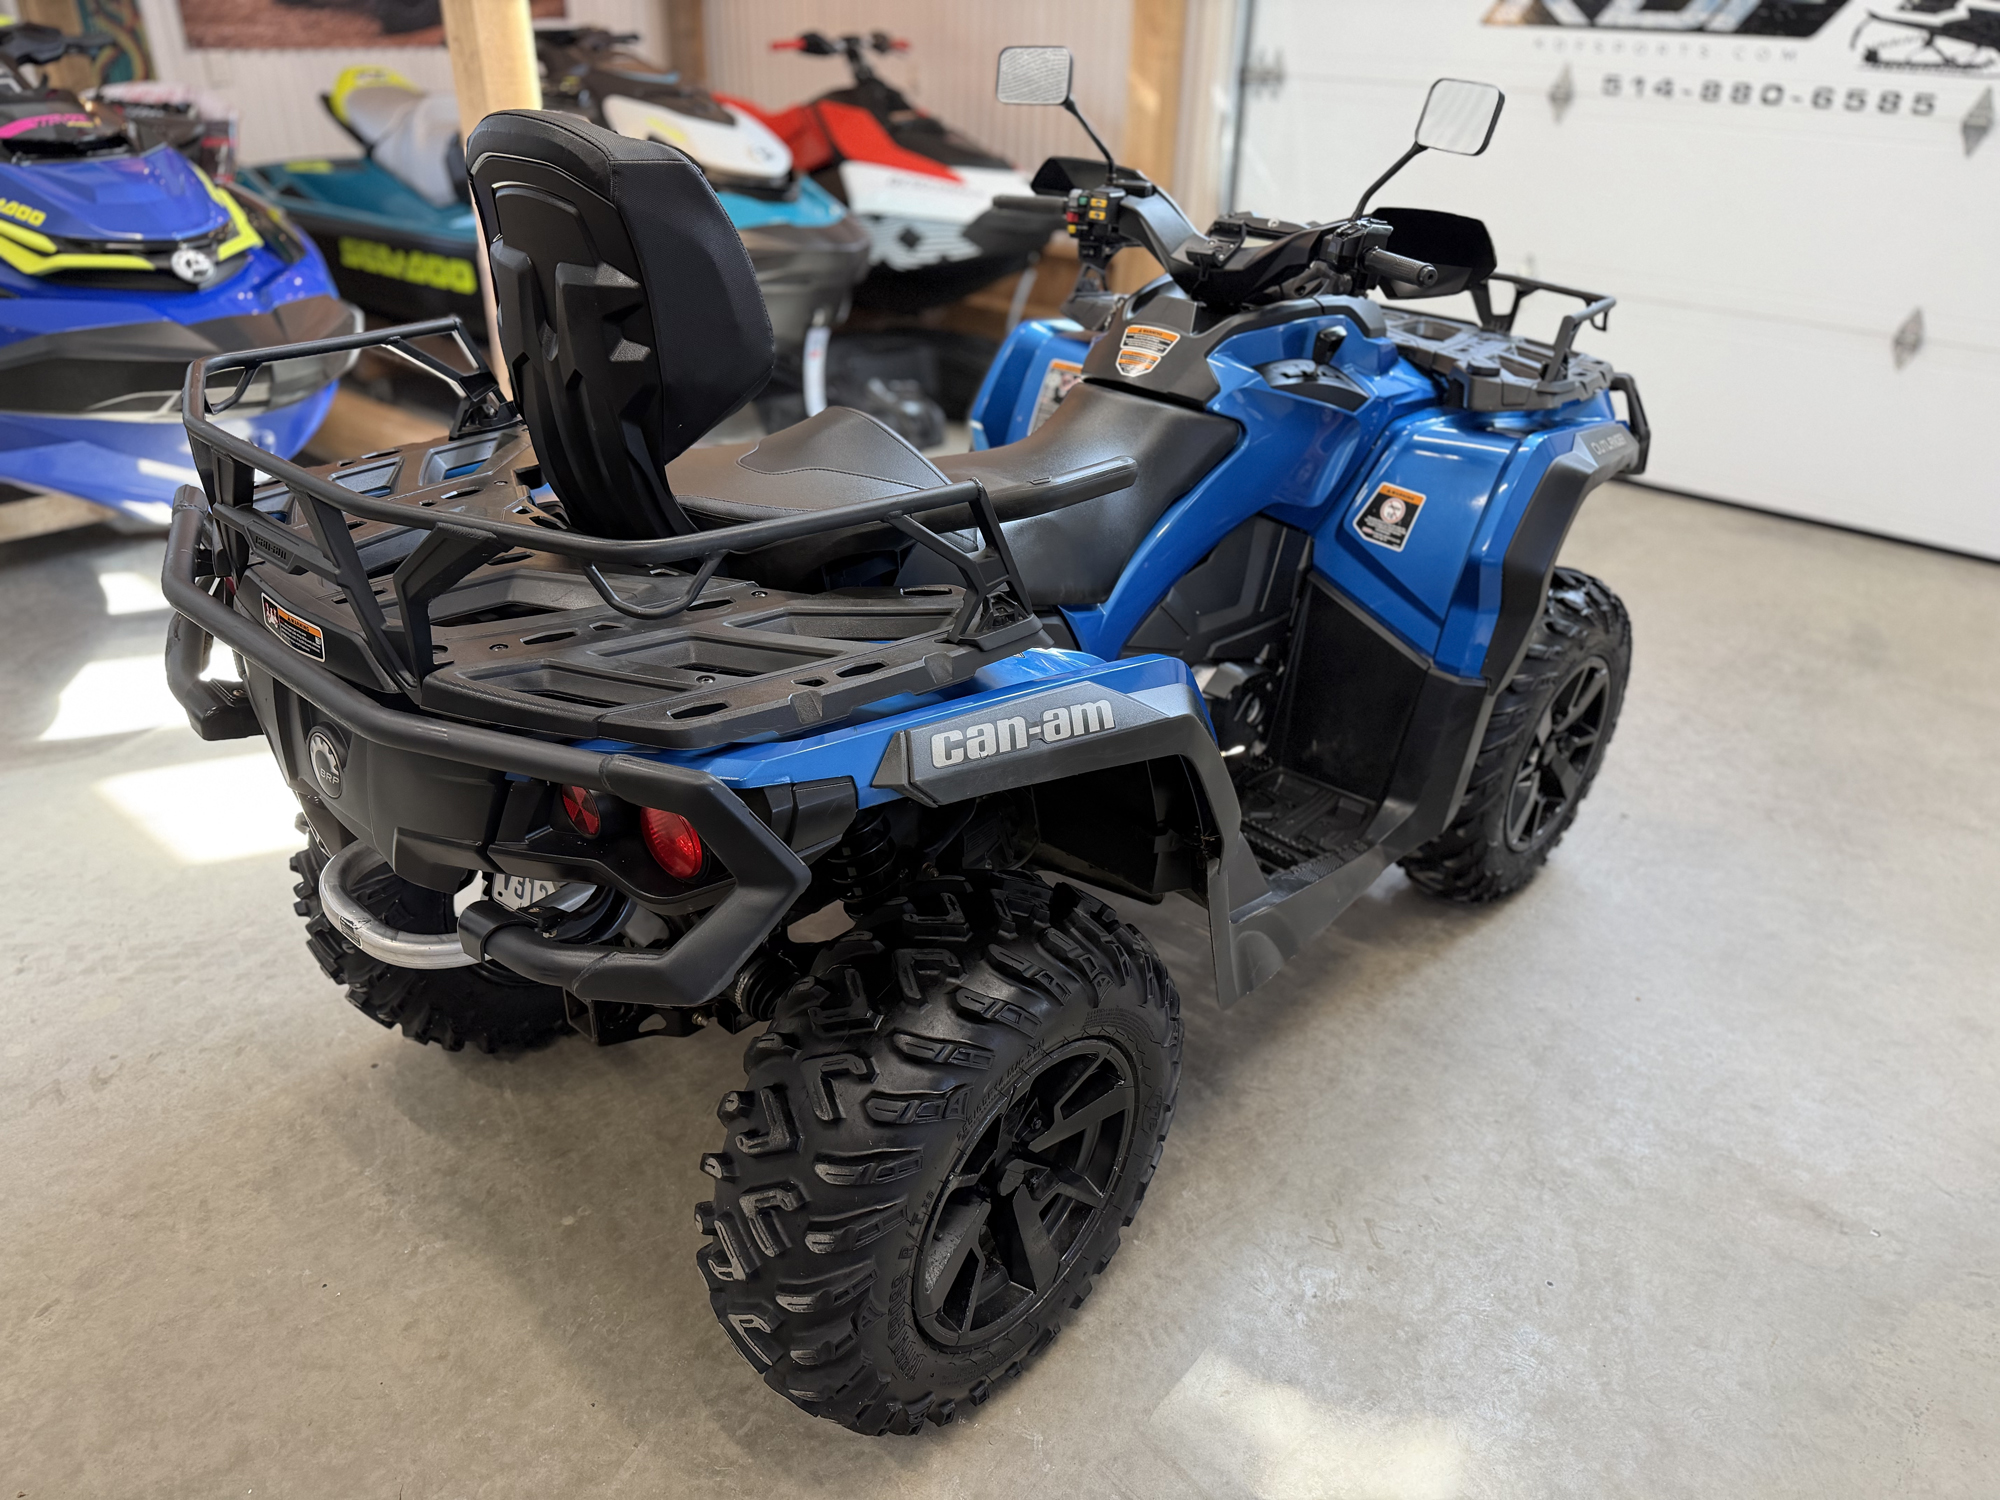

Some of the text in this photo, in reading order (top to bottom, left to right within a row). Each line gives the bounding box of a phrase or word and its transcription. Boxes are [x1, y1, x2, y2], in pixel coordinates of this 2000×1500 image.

[1600, 72, 1938, 117] 514-880-6585
[931, 699, 1116, 769] can-am
[320, 768, 340, 784] BRP
